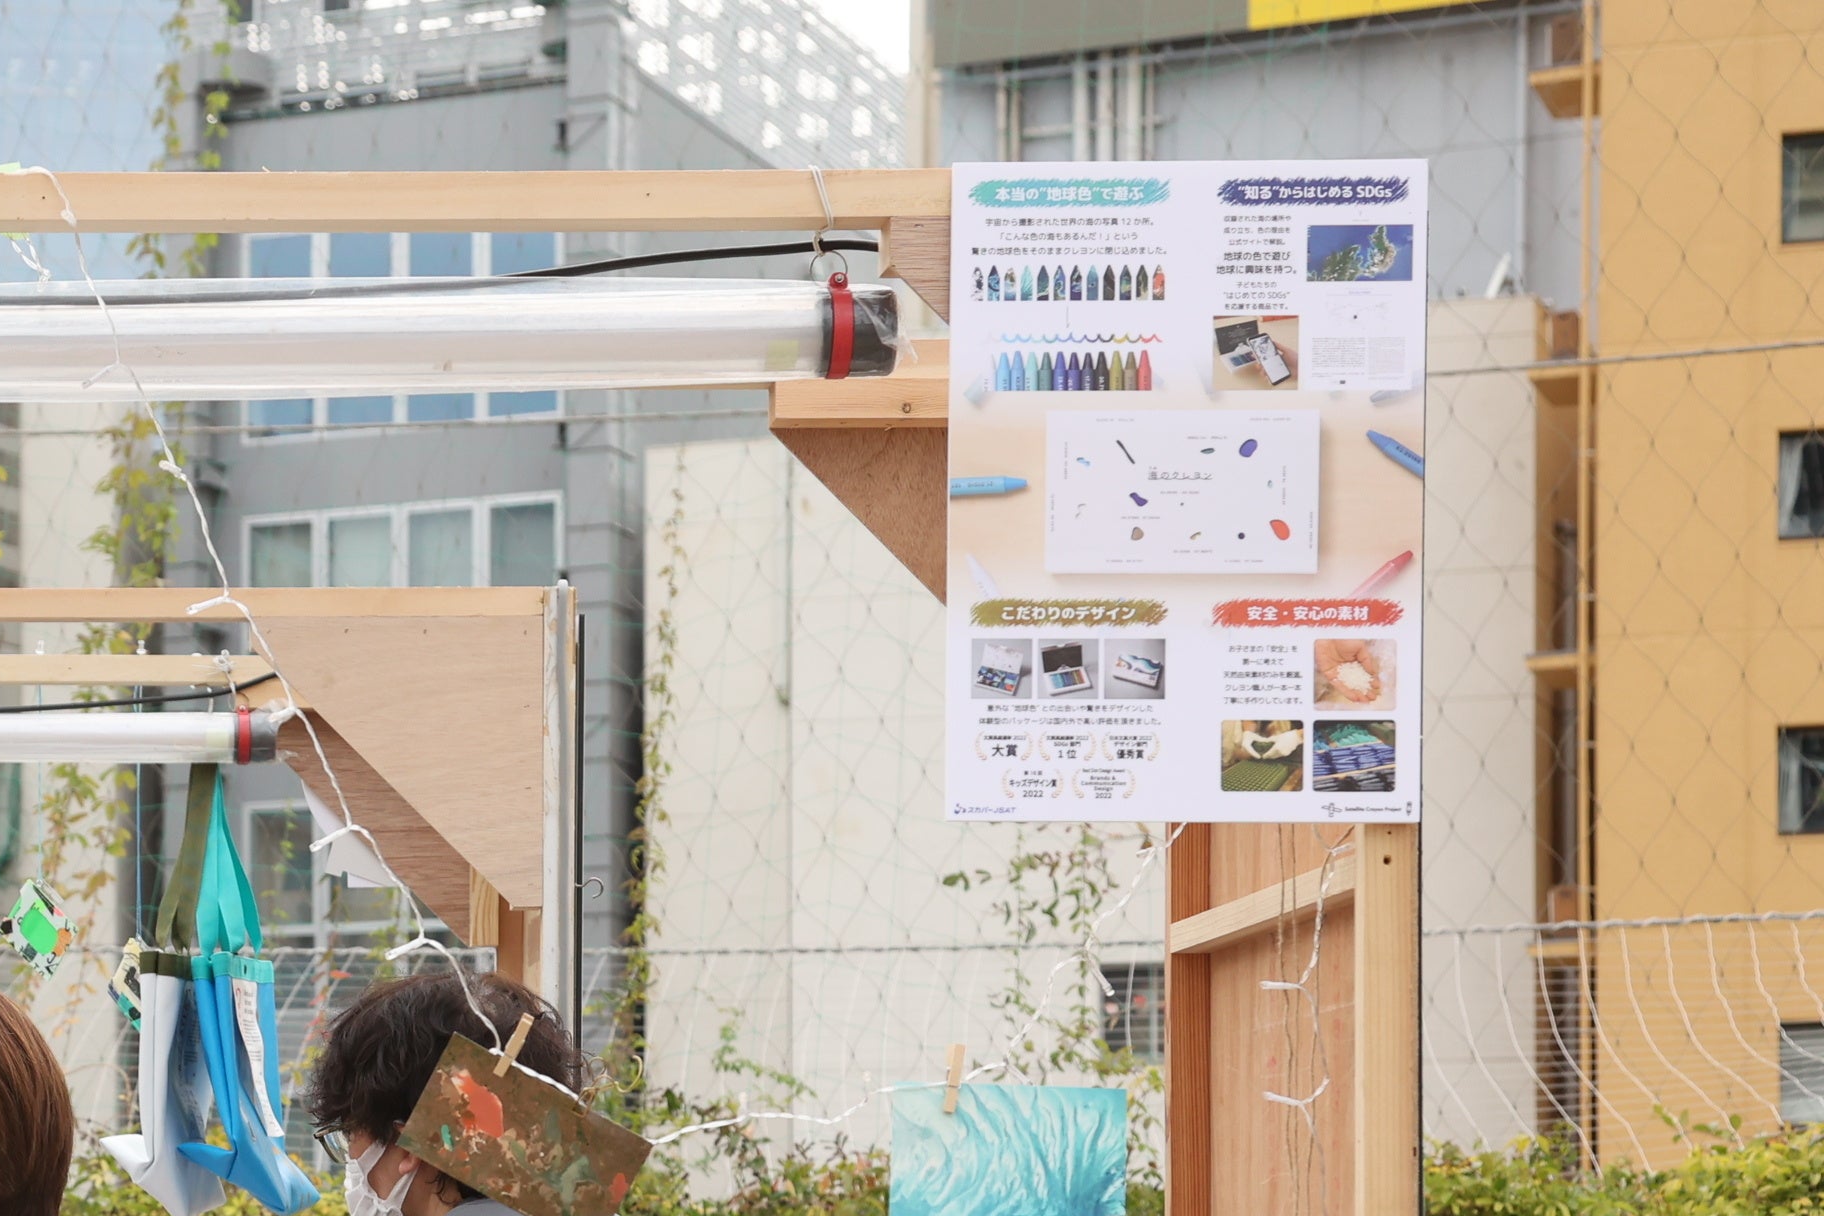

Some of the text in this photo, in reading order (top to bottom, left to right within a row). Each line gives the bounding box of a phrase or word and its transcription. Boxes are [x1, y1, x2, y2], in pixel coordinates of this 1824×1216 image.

[1356, 184, 1393, 199] SDGs
[1121, 218, 1131, 226] 12
[1223, 251, 1291, 262] 地球の色で遊び
[1216, 265, 1298, 275] 地球に興味を持つ。
[1000, 604, 1137, 621] こだわりのデザイン
[1247, 605, 1370, 622] 安全・安心の素材
[991, 744, 1019, 758] 大賞
[1067, 749, 1077, 759] 位
[1116, 749, 1144, 760] 優秀賞
[1022, 790, 1044, 798] 2022
